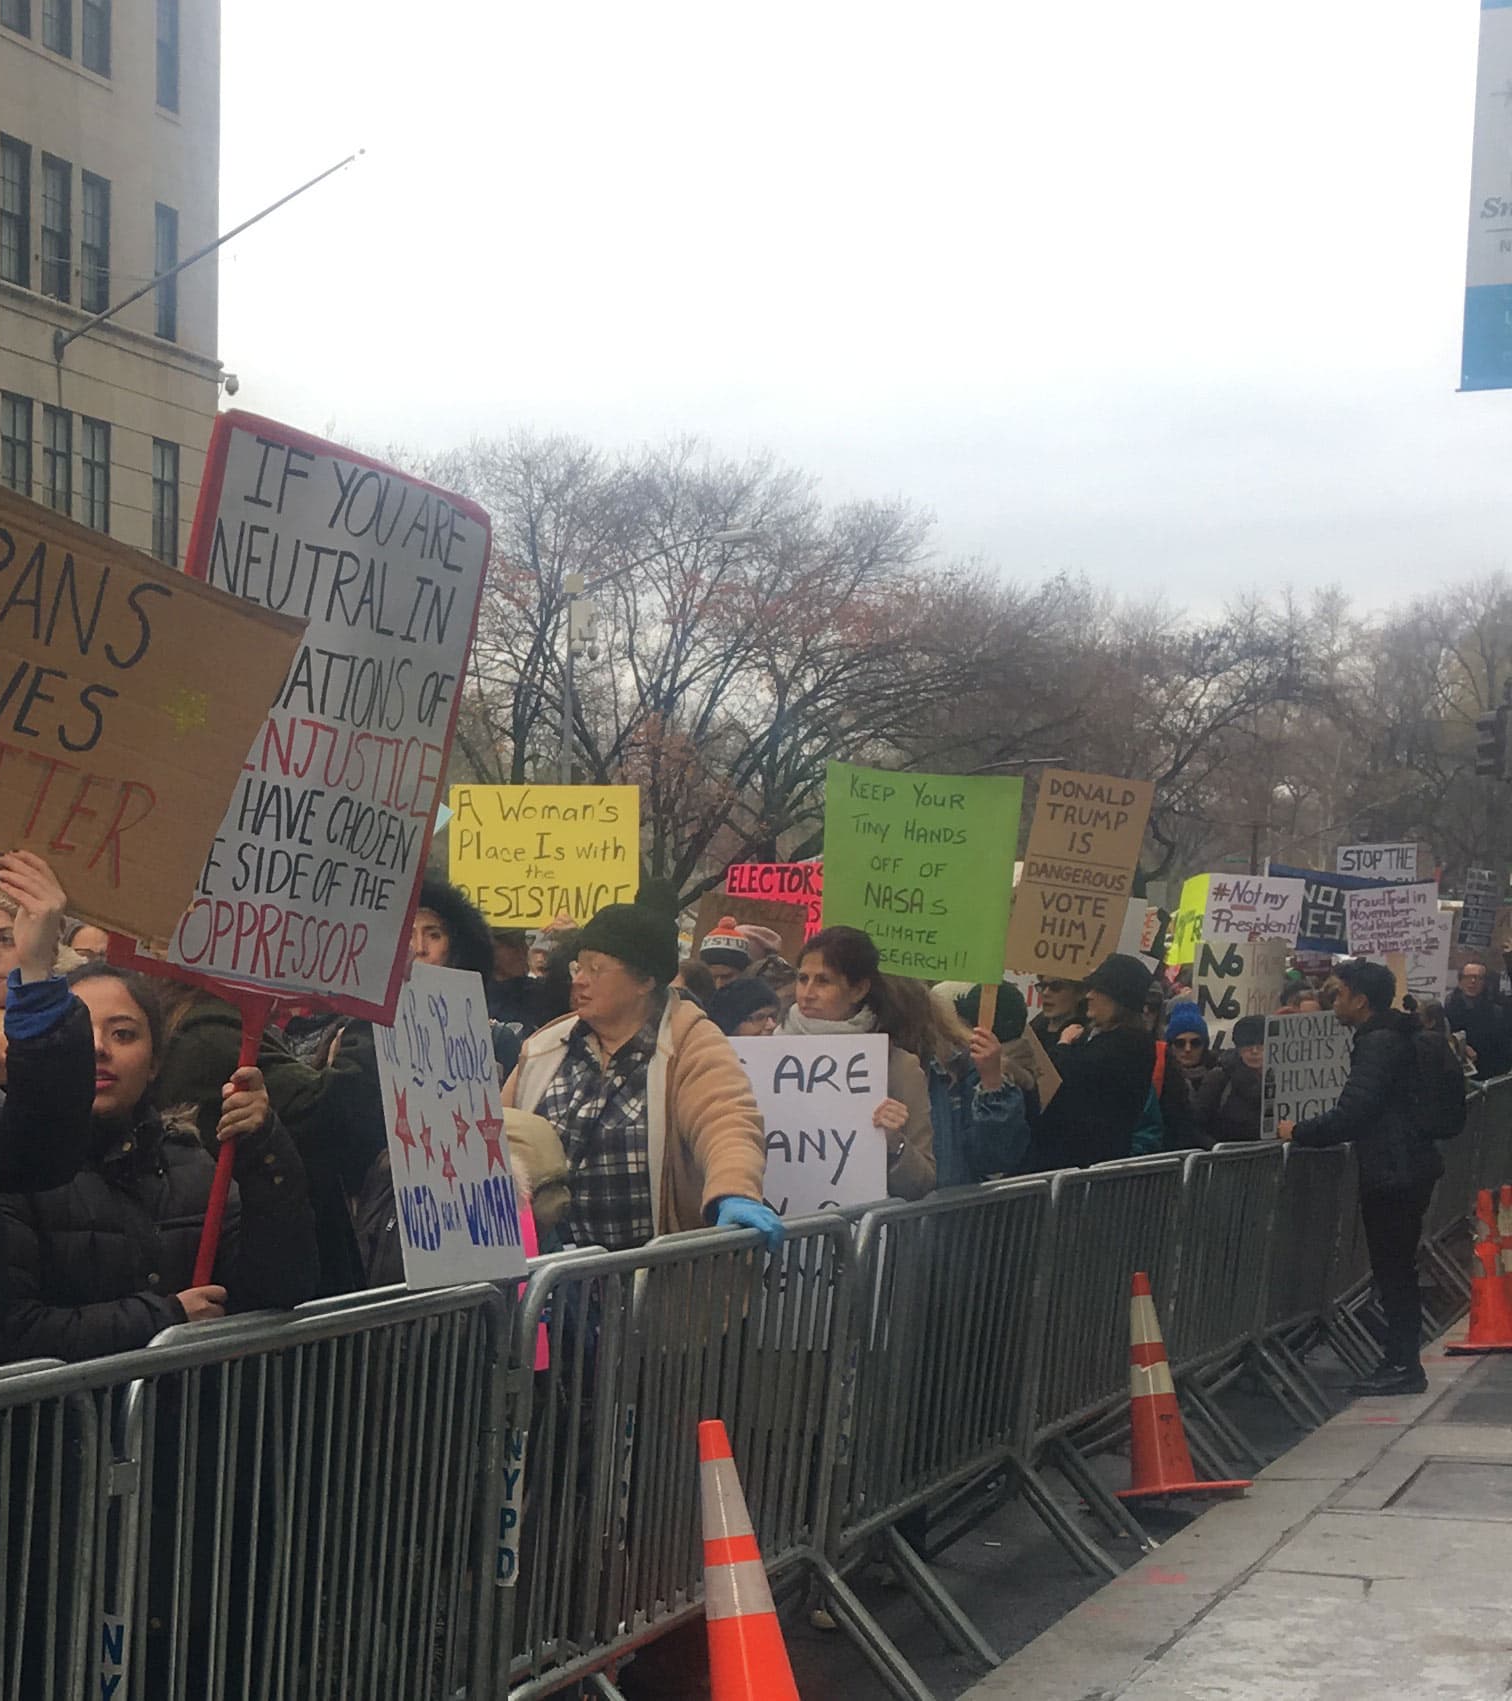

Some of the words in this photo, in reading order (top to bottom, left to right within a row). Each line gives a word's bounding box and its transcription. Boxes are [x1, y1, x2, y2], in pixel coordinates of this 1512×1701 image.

[243, 435, 315, 514] IF
[328, 461, 408, 546] YOU
[401, 494, 467, 573] ARE
[208, 517, 394, 636] NEUTRAL
[400, 576, 456, 645] IN
[270, 645, 413, 732] ATIONS
[418, 671, 456, 727] OF
[241, 717, 443, 818] NJUSTICE
[850, 773, 896, 801] KEEP
[1050, 778, 1136, 807] DONALD
[456, 789, 483, 826] A
[497, 788, 619, 823] Woman's
[1047, 802, 1129, 832] TRUMP
[237, 777, 325, 846] HAVE
[326, 795, 418, 874] CHOSEN
[904, 818, 968, 845] HANDS
[458, 829, 526, 862] Place
[535, 832, 565, 861] Is
[575, 836, 626, 861] with
[1067, 831, 1094, 855] IS
[525, 864, 555, 879] the
[871, 855, 904, 875] OFF
[919, 862, 948, 878] OF
[1341, 849, 1383, 871] STOP
[1384, 848, 1415, 870] THE
[232, 842, 313, 900] SIDE
[312, 858, 348, 907] OF
[350, 866, 396, 911] THE
[1026, 862, 1128, 891] DANGEROUS
[1040, 891, 1109, 918] VOTE
[178, 898, 368, 986] OPPRESSOR
[864, 919, 938, 945] CLIMATE
[1040, 915, 1088, 941] HIM
[1268, 1038, 1335, 1065] RIGHTS
[773, 1051, 871, 1094] ARE
[398, 1184, 441, 1251] VOTED
[459, 1175, 521, 1247] WOMAN
